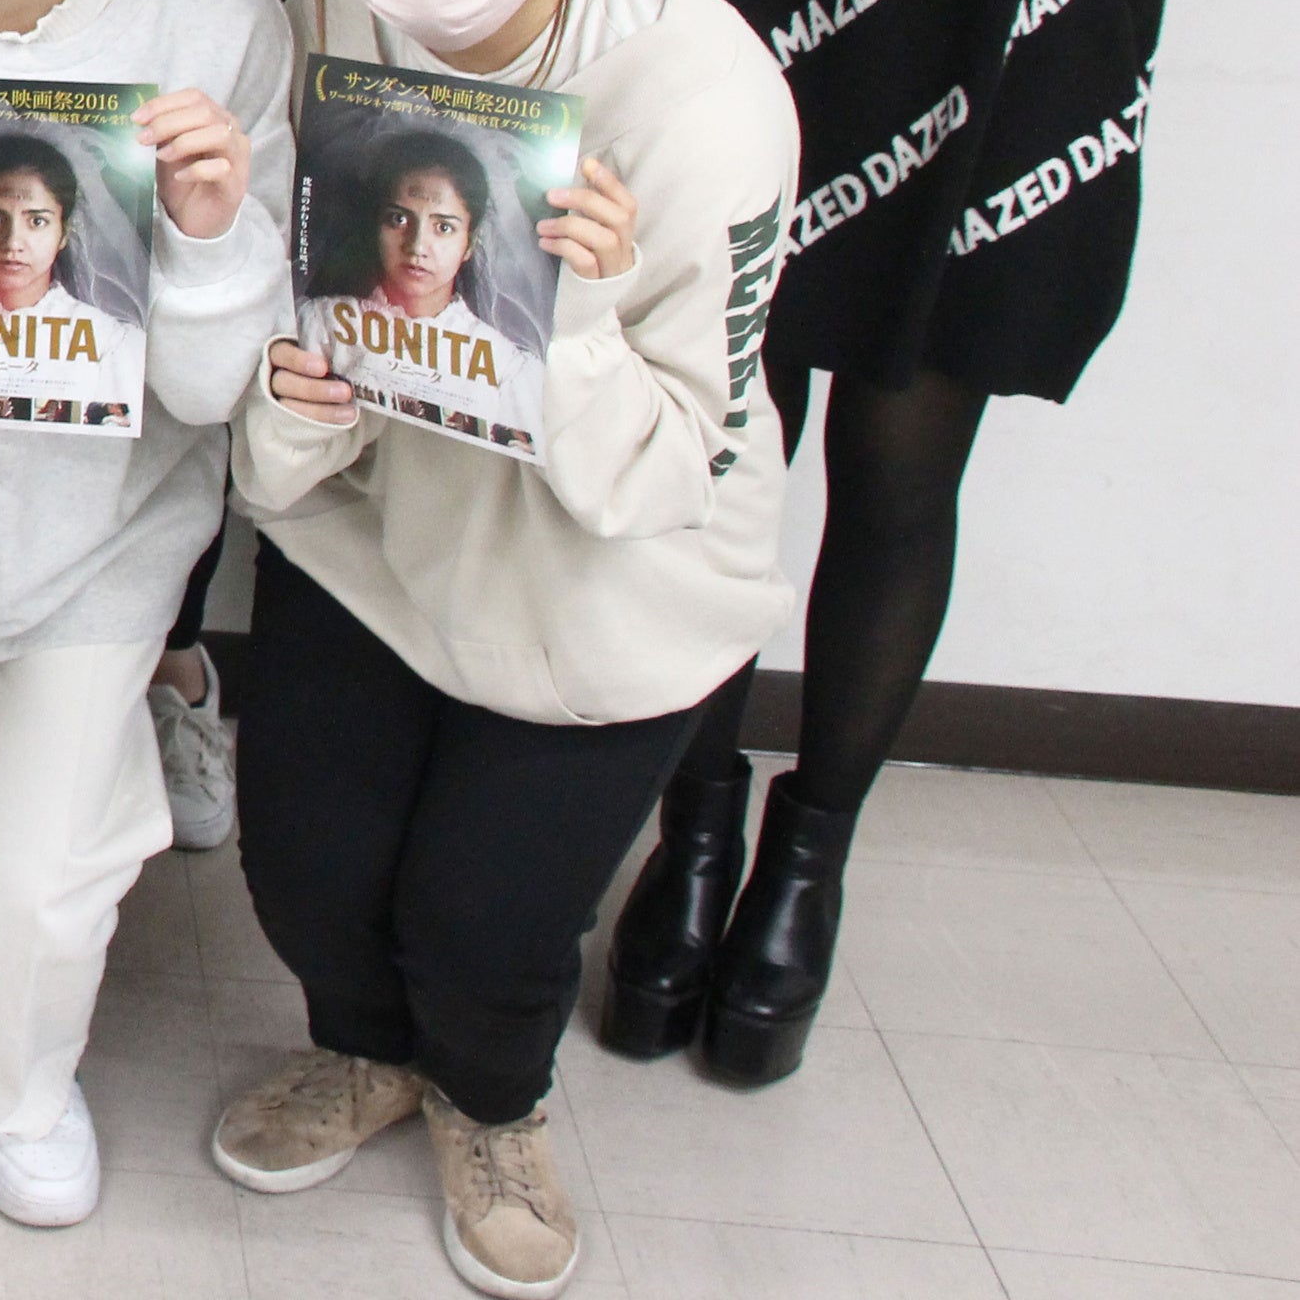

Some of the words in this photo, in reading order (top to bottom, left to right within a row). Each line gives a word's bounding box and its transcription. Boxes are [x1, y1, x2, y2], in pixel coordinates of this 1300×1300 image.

[343, 71, 542, 120] サンダンス映画祭2016
[862, 85, 970, 199] DAZED
[333, 302, 499, 387] SONITA
